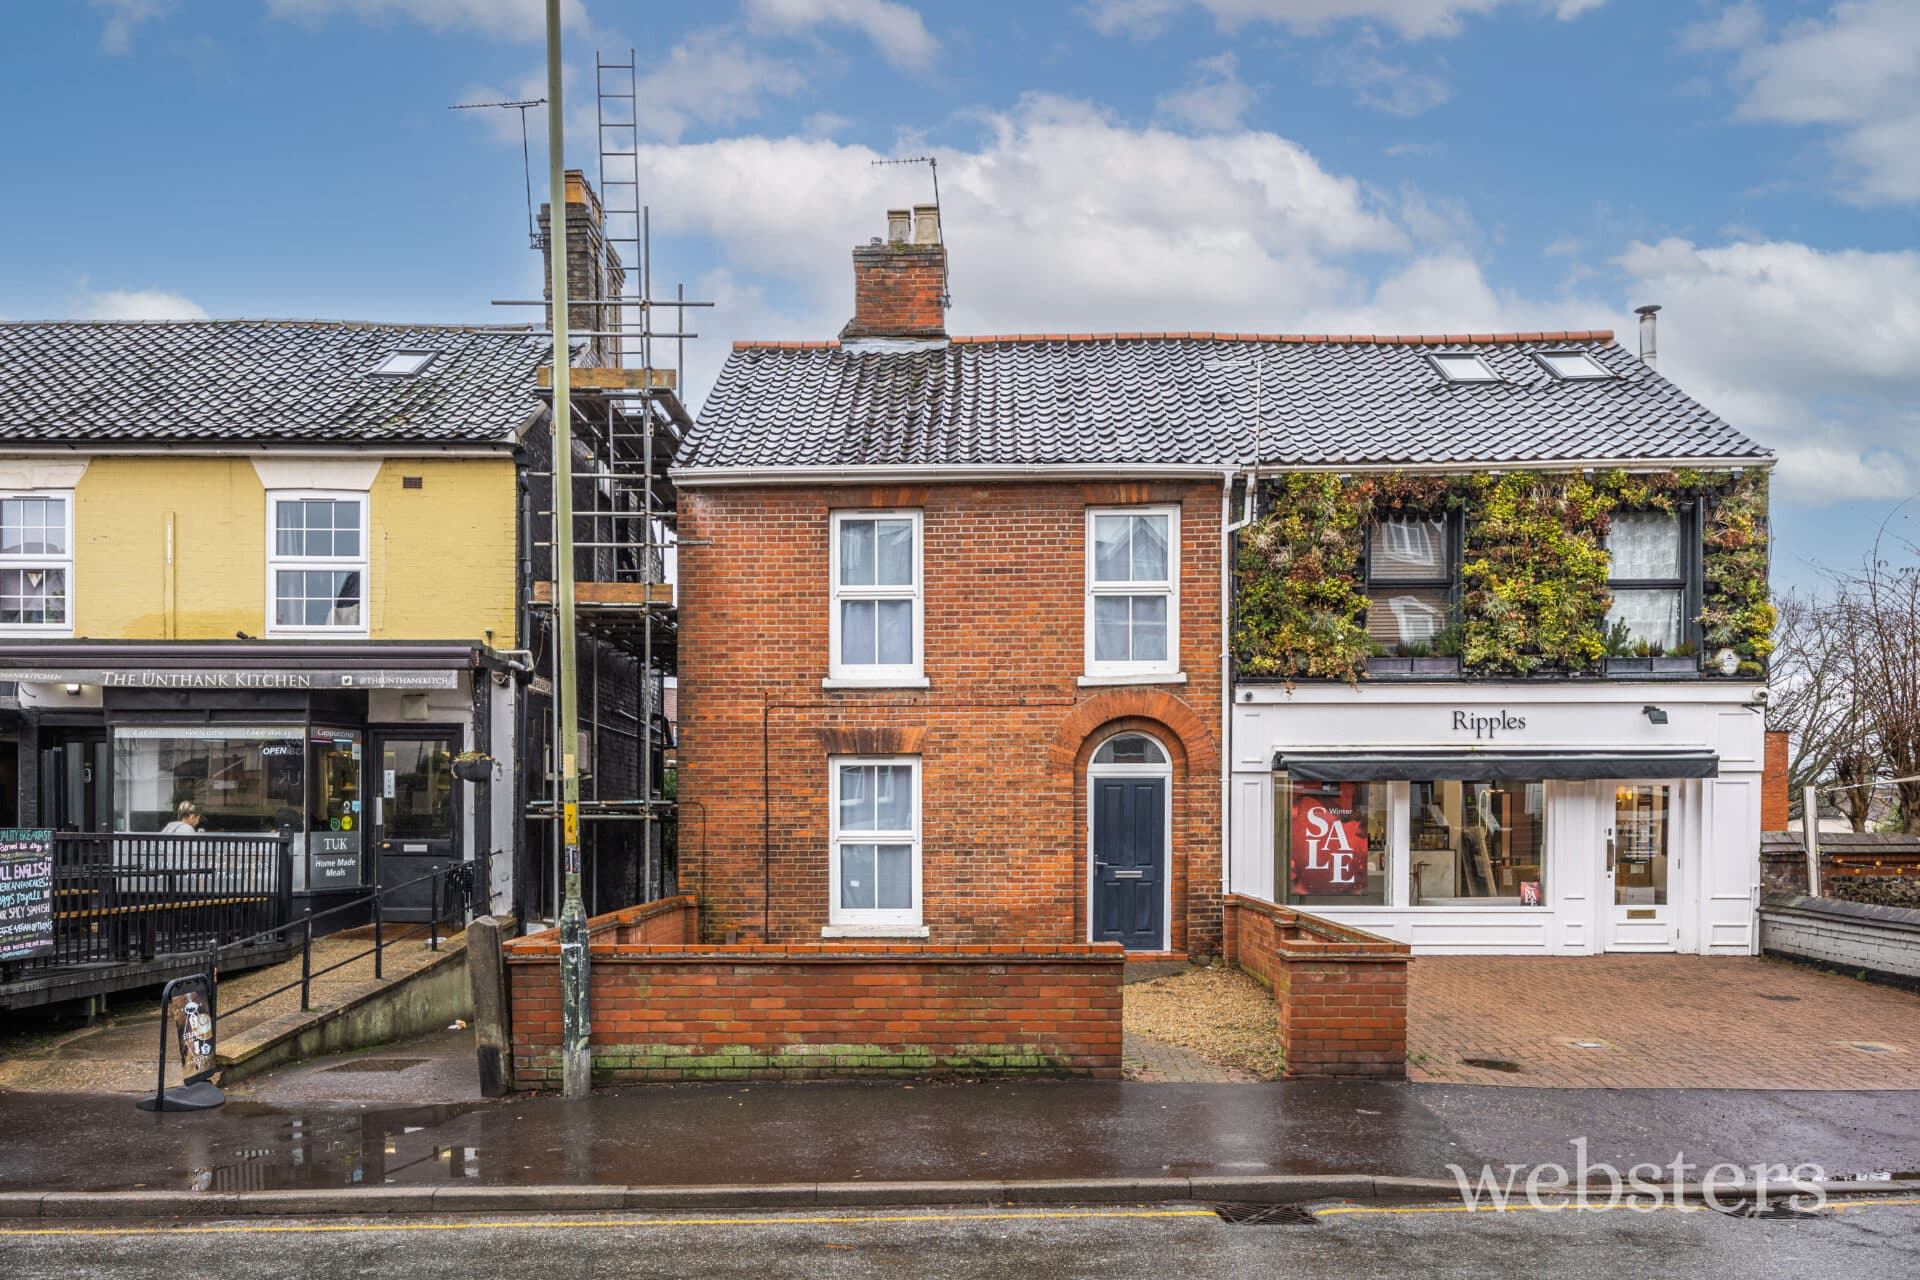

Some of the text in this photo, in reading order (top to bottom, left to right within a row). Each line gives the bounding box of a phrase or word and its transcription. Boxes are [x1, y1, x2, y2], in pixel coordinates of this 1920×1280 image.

[102, 671, 310, 687] THE UNTHANK KITCHEN
[1452, 709, 1527, 739] Ripples
[262, 746, 287, 755] OPEN
[323, 838, 348, 850] TUK
[337, 858, 356, 866] Made
[14, 862, 51, 879] ENGLISH
[325, 868, 346, 877] Meals
